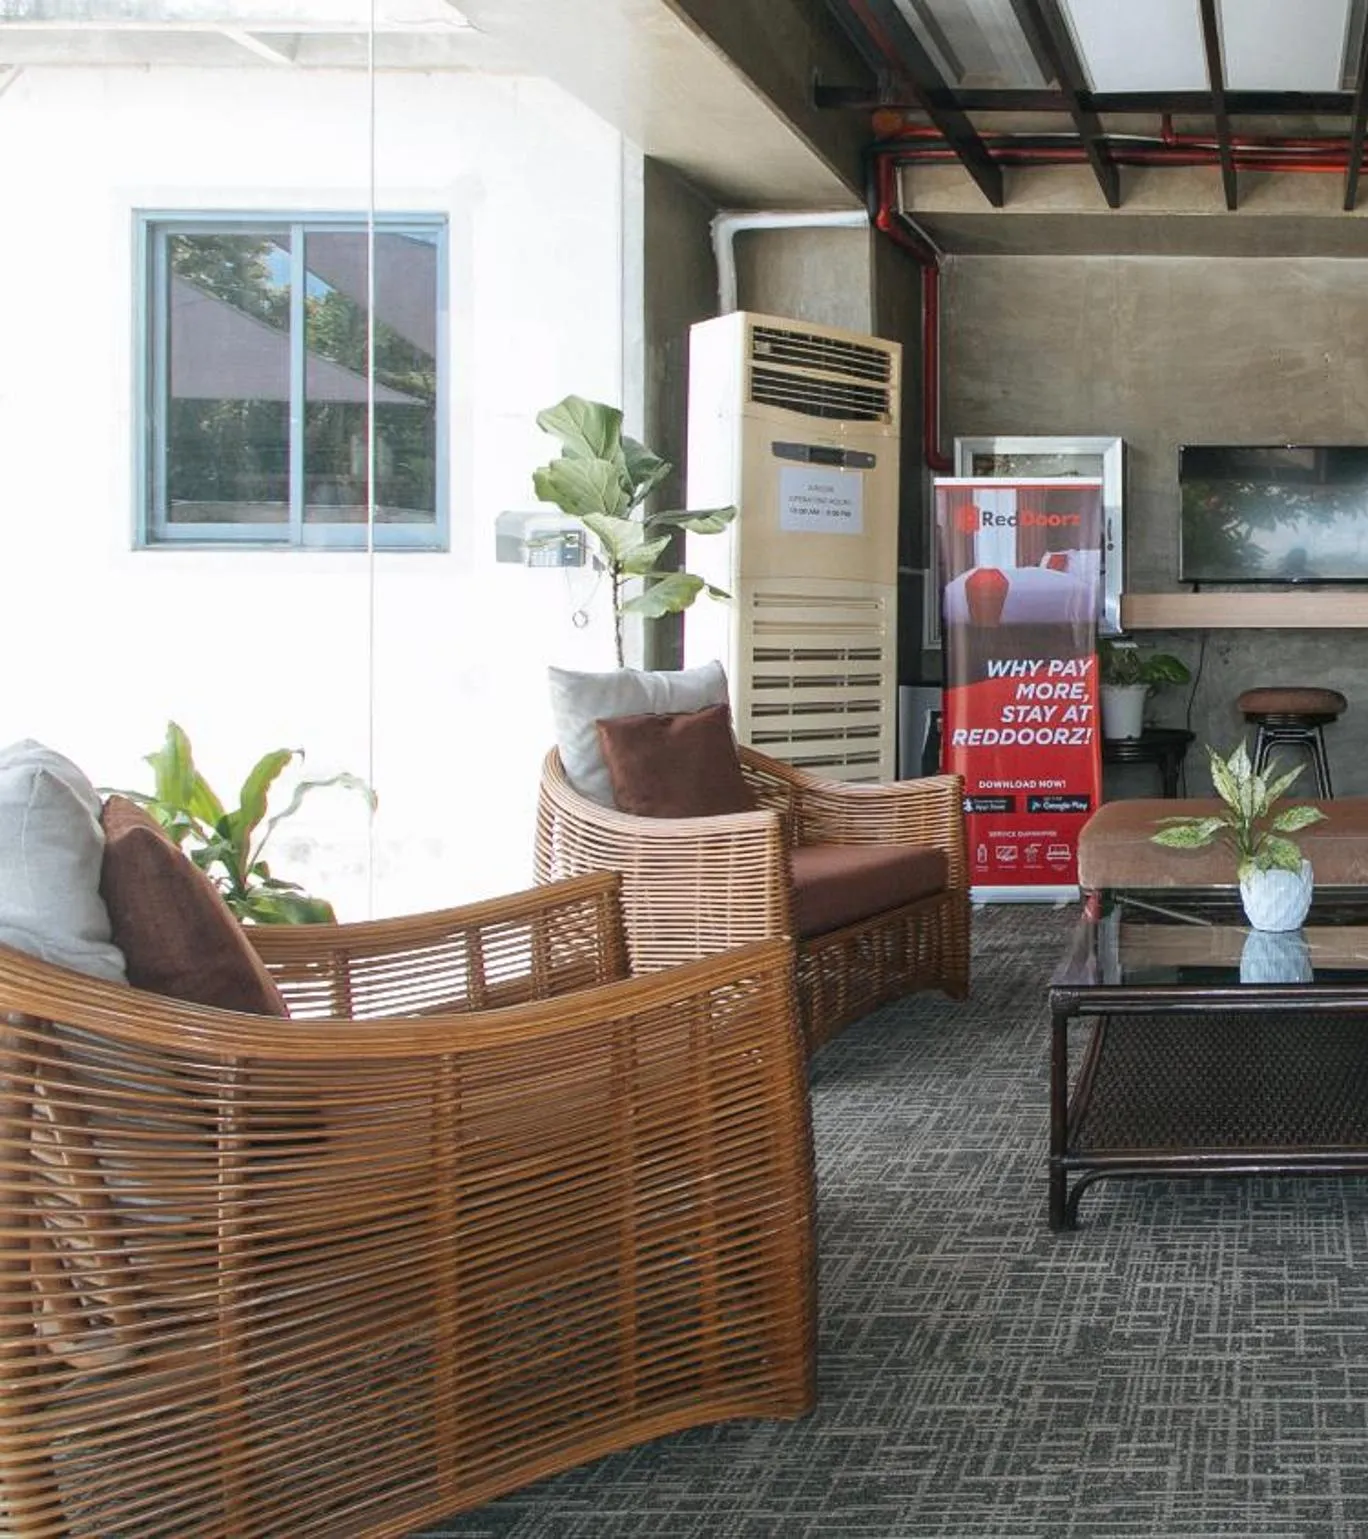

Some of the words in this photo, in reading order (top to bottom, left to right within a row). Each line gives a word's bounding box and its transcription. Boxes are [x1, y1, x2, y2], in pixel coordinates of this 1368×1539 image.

[982, 510, 1080, 528] RedDoorz
[987, 659, 1044, 678] WHY
[1048, 659, 1093, 677] PAY
[1016, 682, 1089, 703] MORE,
[1001, 705, 1058, 723] STAY
[1061, 705, 1093, 722] AT
[952, 727, 1092, 745] REDDOORZ!
[978, 780, 1037, 789] DOWNLOAD
[1038, 780, 1067, 789] NOW!
[1042, 801, 1071, 812] Google
[1072, 801, 1088, 811] Play
